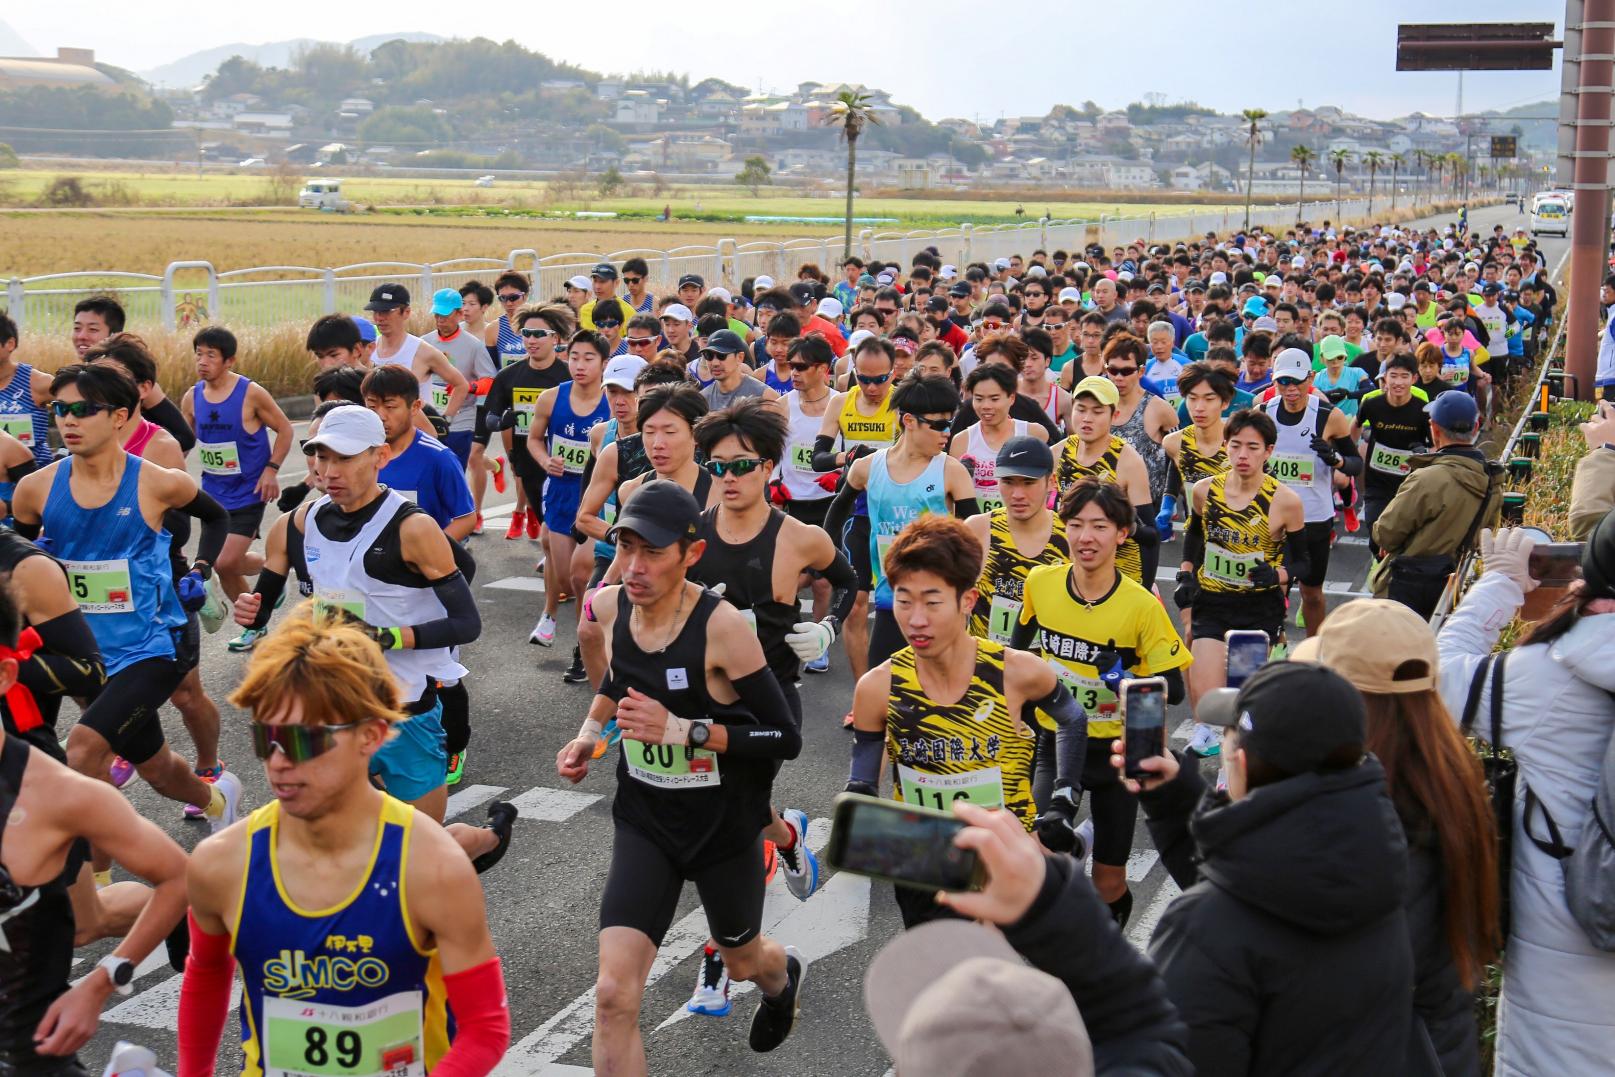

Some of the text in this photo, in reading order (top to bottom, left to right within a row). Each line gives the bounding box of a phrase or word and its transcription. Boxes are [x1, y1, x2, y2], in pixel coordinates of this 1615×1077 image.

[847, 422, 886, 432] KITSUKI
[200, 449, 224, 466] 205
[557, 445, 586, 464] 846
[796, 449, 813, 465] 43
[1376, 451, 1401, 467] 826
[1272, 462, 1299, 477] 408
[892, 505, 918, 519] We
[1214, 555, 1246, 577] 119
[73, 574, 88, 599] 5
[642, 744, 673, 769] 80
[899, 734, 1000, 763] 長崎国際大学
[263, 949, 390, 993] SUMCO
[303, 1026, 363, 1069] 89
